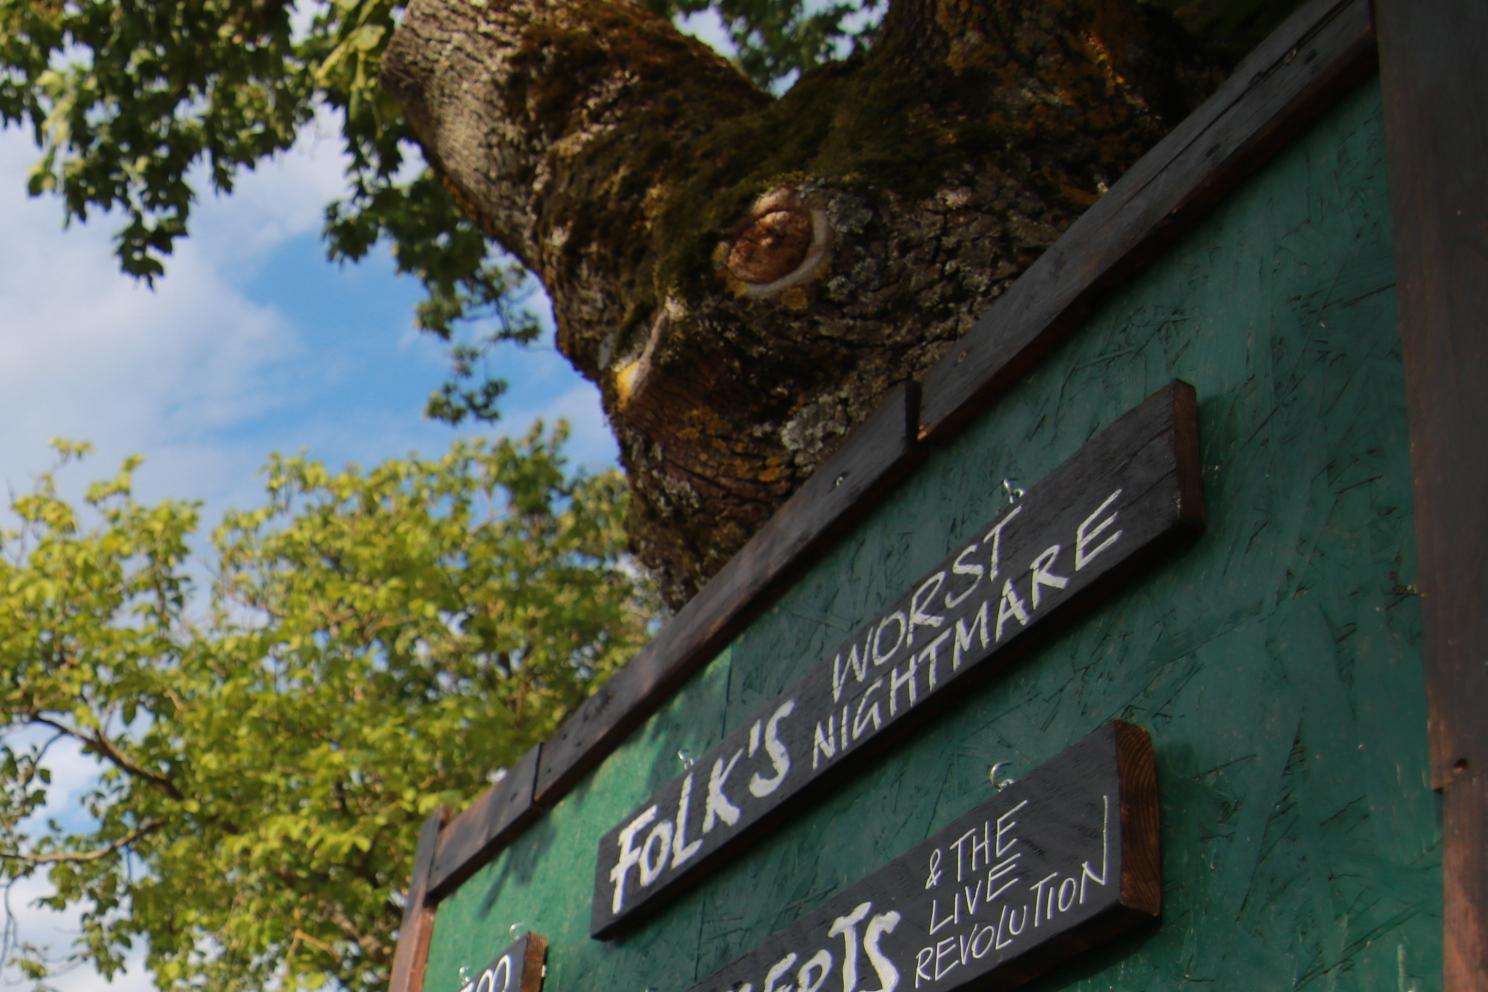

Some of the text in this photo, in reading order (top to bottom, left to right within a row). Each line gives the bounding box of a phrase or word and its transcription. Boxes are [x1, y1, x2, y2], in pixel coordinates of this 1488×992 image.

[811, 487, 1125, 771] NIGHTMARE
[831, 506, 1023, 704] WORST
[610, 699, 797, 916] FOLK'S
[914, 794, 1108, 989] REVOLUTION
[925, 799, 1028, 890] & THE
[929, 852, 1021, 936] LIVE
